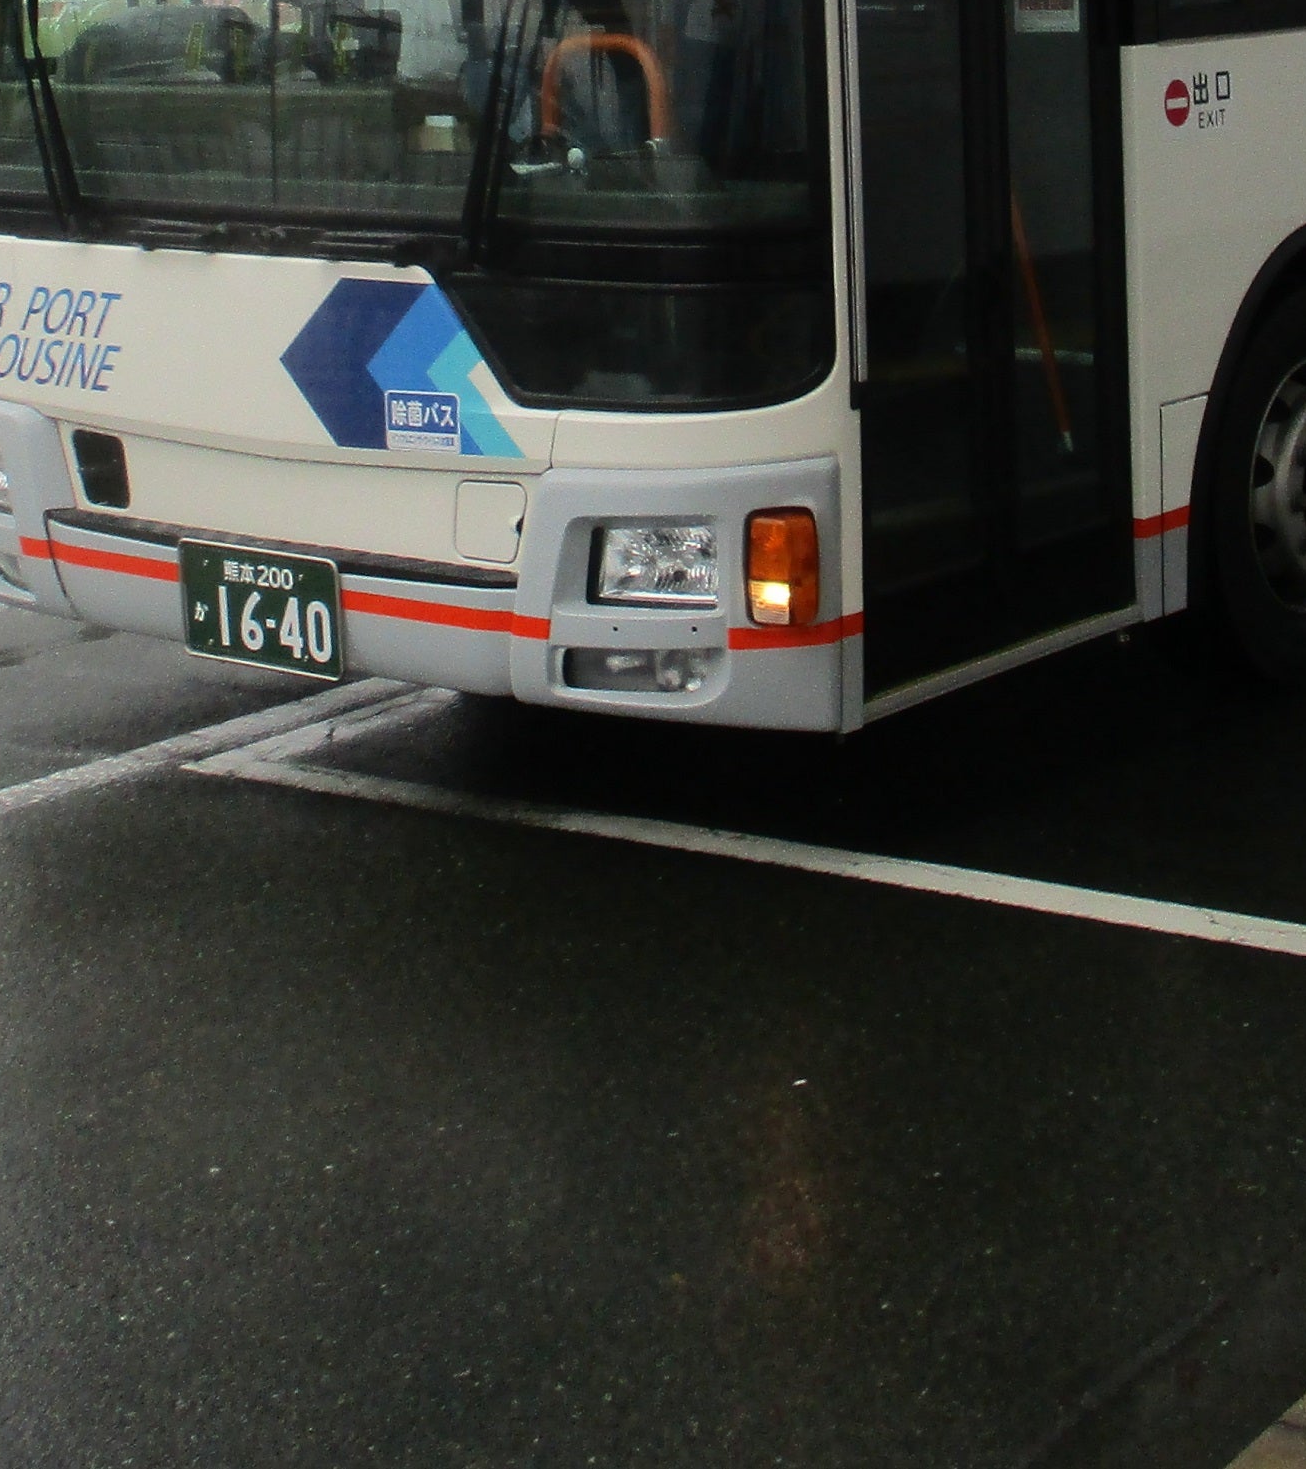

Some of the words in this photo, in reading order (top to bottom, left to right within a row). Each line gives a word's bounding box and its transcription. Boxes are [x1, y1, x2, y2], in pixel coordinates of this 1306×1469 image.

[1192, 70, 1231, 105] 出口
[1198, 108, 1226, 129] EXIT
[20, 286, 123, 339] PORT
[390, 399, 455, 428] 除菌バス
[218, 585, 333, 664] 16-40
